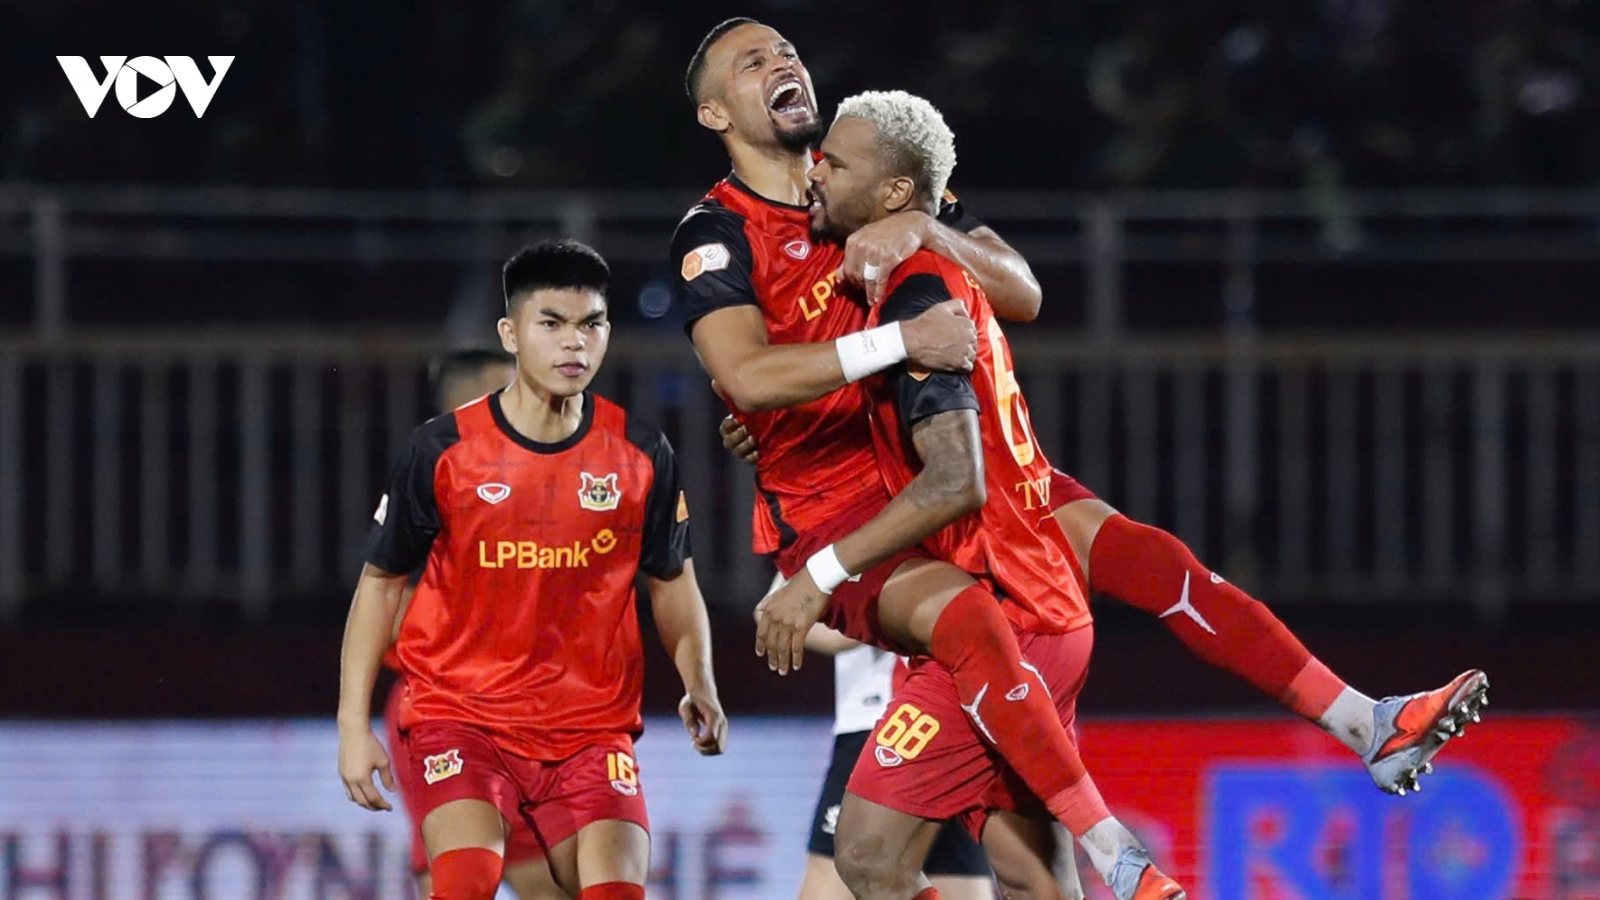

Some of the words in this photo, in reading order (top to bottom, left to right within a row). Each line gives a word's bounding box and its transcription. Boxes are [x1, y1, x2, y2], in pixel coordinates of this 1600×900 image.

[479, 540, 590, 568] LPBank
[876, 703, 940, 760] 68
[606, 751, 637, 788] 16
